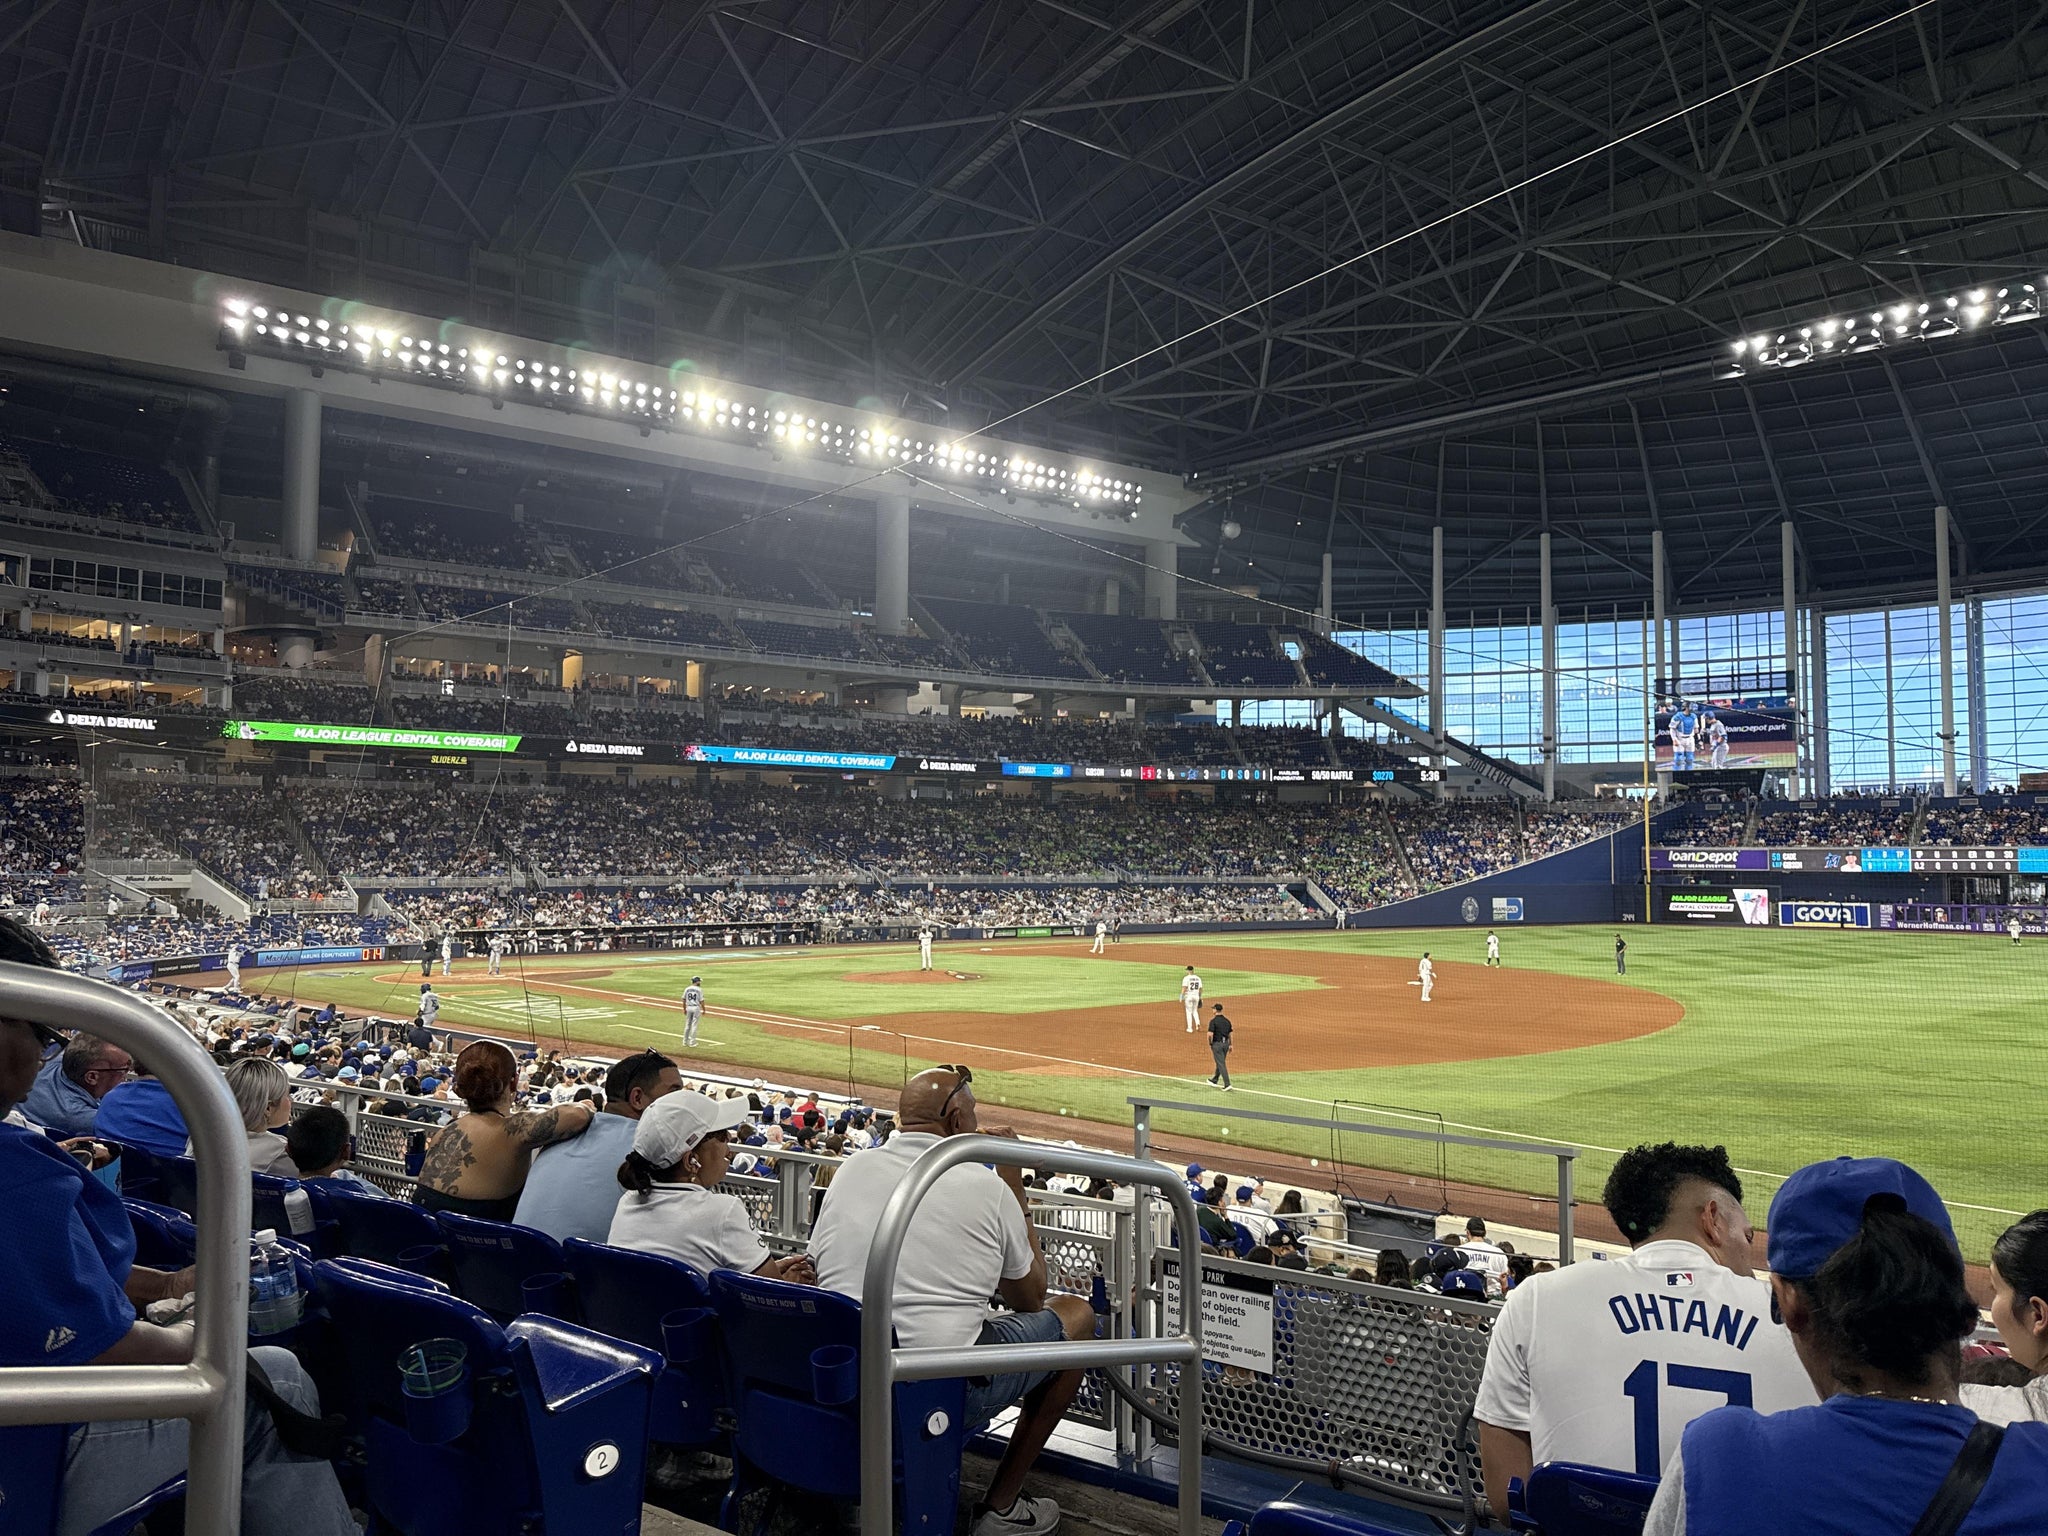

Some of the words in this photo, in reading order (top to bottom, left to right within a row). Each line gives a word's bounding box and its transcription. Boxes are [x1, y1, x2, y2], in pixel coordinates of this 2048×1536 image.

[68, 714, 106, 727] DELTA
[107, 716, 154, 730] DENTAL
[1768, 722, 1787, 732] park
[294, 727, 340, 740] MAJOR
[341, 729, 392, 743] LEAGUE
[393, 733, 441, 746] DENTAL
[443, 735, 508, 748] COVERAGE
[579, 743, 607, 754] DELTA
[608, 744, 643, 756] DENTAL
[734, 751, 768, 761] MAJOR
[768, 752, 804, 763] LEAGUE
[804, 755, 840, 765] DENTAL
[840, 757, 885, 768] COVERAGE
[929, 761, 950, 770] DELTA
[950, 762, 976, 772] DENTAL
[1156, 769, 1162, 779] 2
[1203, 769, 1209, 779] 3
[1311, 770, 1330, 780] 50/50
[1330, 770, 1353, 780] RAFFLE
[1420, 770, 1440, 781] 5:36
[1465, 755, 1486, 774] 300
[1486, 767, 1514, 789] LEVEL
[1668, 850, 1738, 864] loanDepot
[1796, 906, 1852, 922] GOYA
[687, 992, 698, 1002] 84
[1070, 1175, 1087, 1190] 17
[1469, 1252, 1489, 1263] HTANI
[1206, 1271, 1225, 1284] PARK
[1456, 1276, 1466, 1289] LA
[1168, 1281, 1180, 1291] Do
[740, 1292, 756, 1304] SCAN
[756, 1296, 766, 1305] TO
[766, 1298, 779, 1307] BET
[780, 1300, 796, 1308] NOW
[1201, 1287, 1217, 1298] ean
[1220, 1292, 1240, 1303] over
[1241, 1295, 1270, 1311] railing
[1202, 1300, 1212, 1309] of
[1213, 1303, 1246, 1317] objects
[1201, 1311, 1216, 1322] the
[1217, 1314, 1241, 1328] field.
[1608, 1293, 1760, 1351] OHTANI
[1204, 1328, 1235, 1341] apoyarse.
[1206, 1340, 1229, 1350] objetos
[1230, 1345, 1242, 1353] que
[1244, 1346, 1266, 1358] salgan
[1211, 1348, 1231, 1359] juego.
[935, 1416, 941, 1430] 1
[597, 1451, 609, 1470] 2
